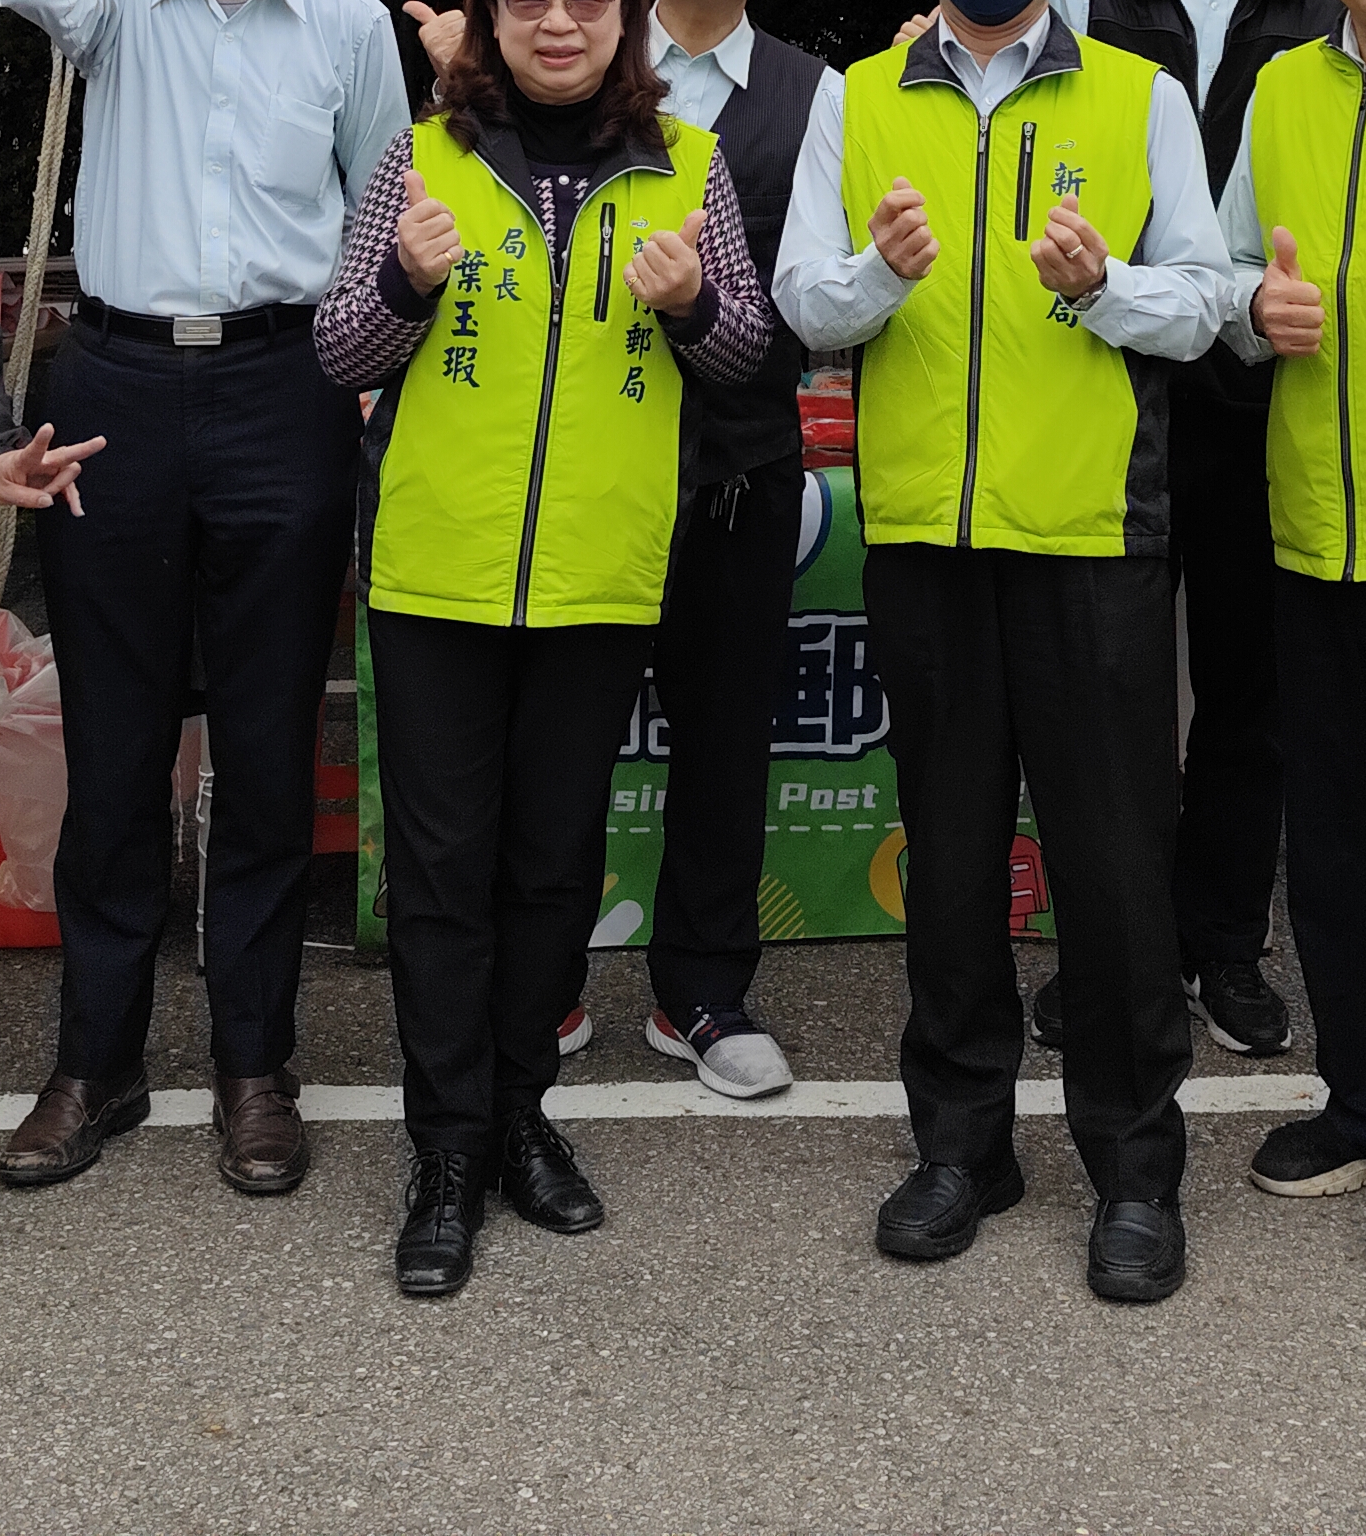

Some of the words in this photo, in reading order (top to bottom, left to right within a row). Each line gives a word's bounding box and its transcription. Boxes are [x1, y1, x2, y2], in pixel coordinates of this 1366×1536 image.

[493, 228, 527, 302] 局長
[1046, 162, 1087, 329] 新局
[779, 783, 879, 810] Post
